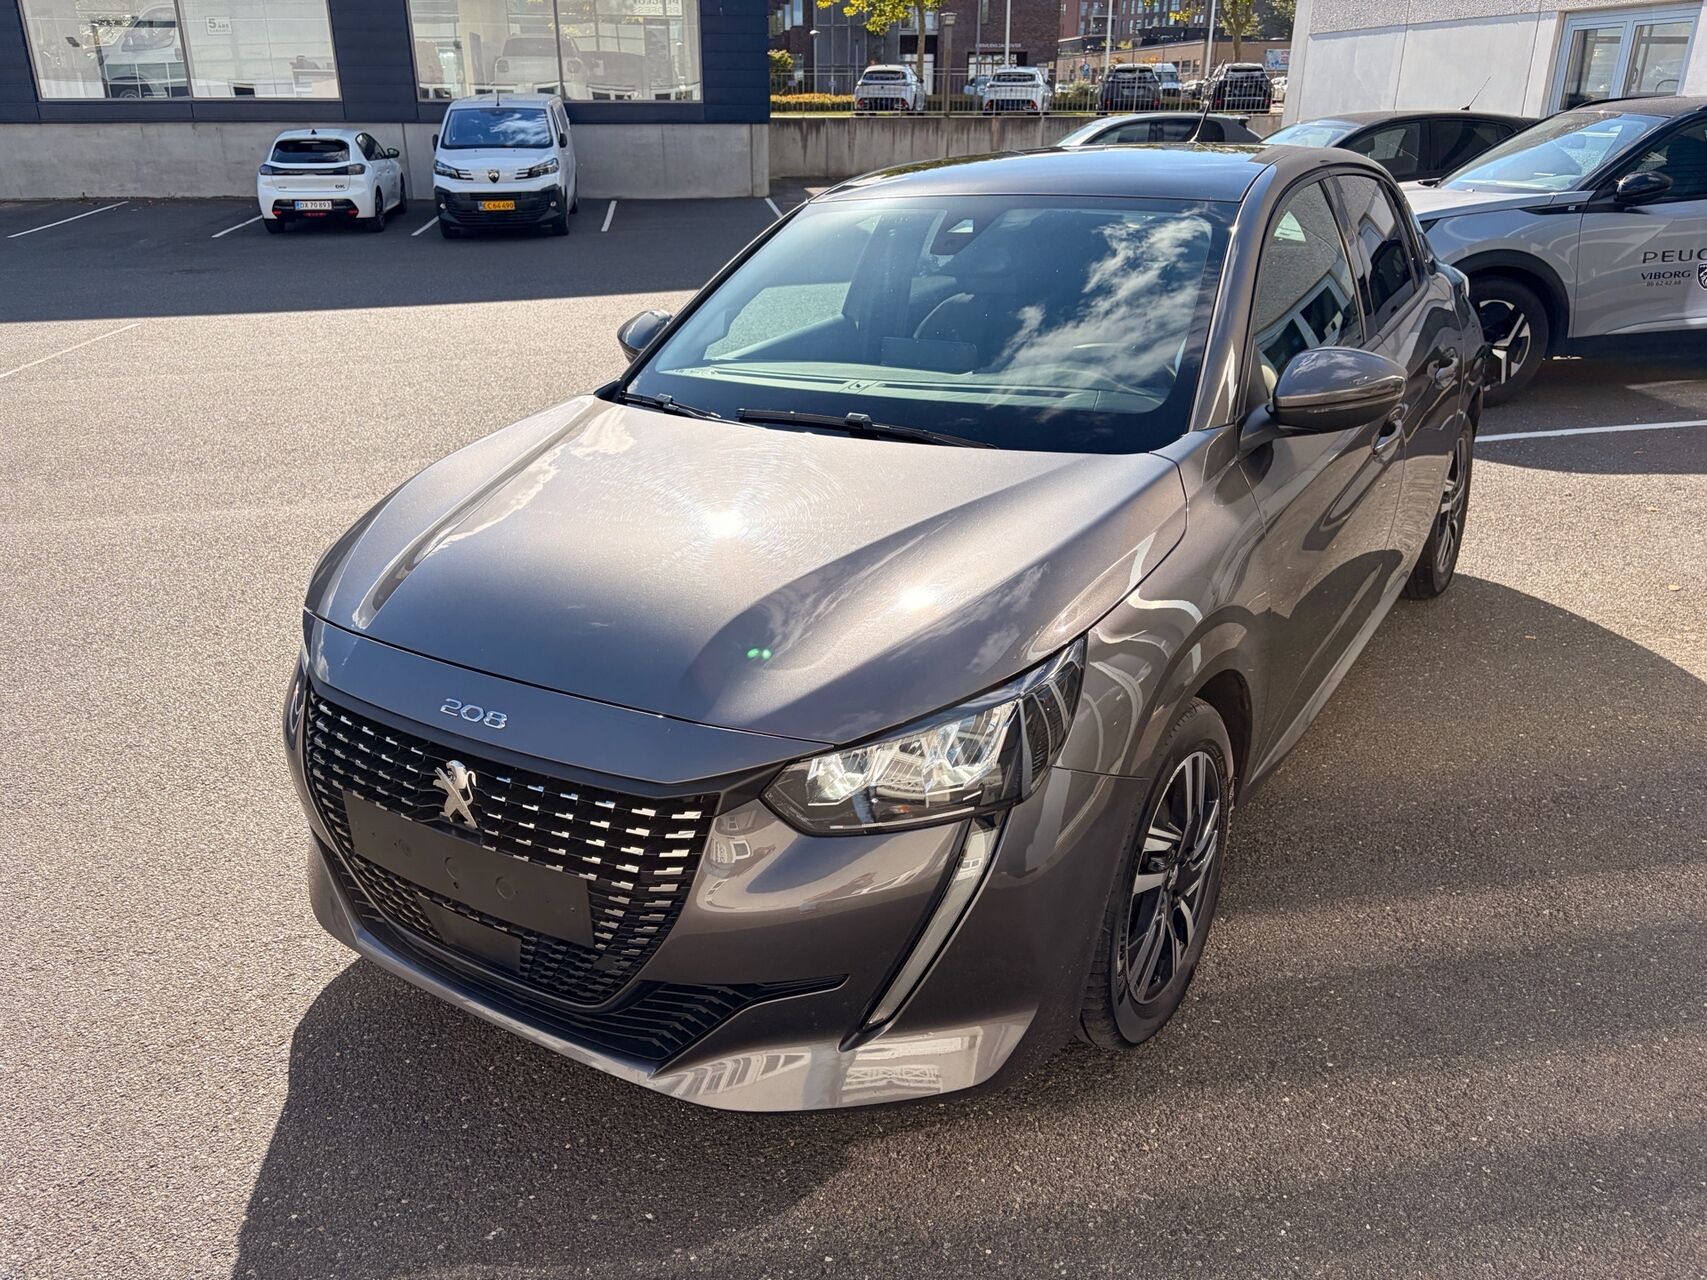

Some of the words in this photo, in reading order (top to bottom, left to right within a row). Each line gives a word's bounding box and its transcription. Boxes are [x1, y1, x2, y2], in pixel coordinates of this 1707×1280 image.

[208, 18, 217, 28] 5
[1641, 270, 1691, 280] VIBORG
[440, 698, 508, 730] 208
